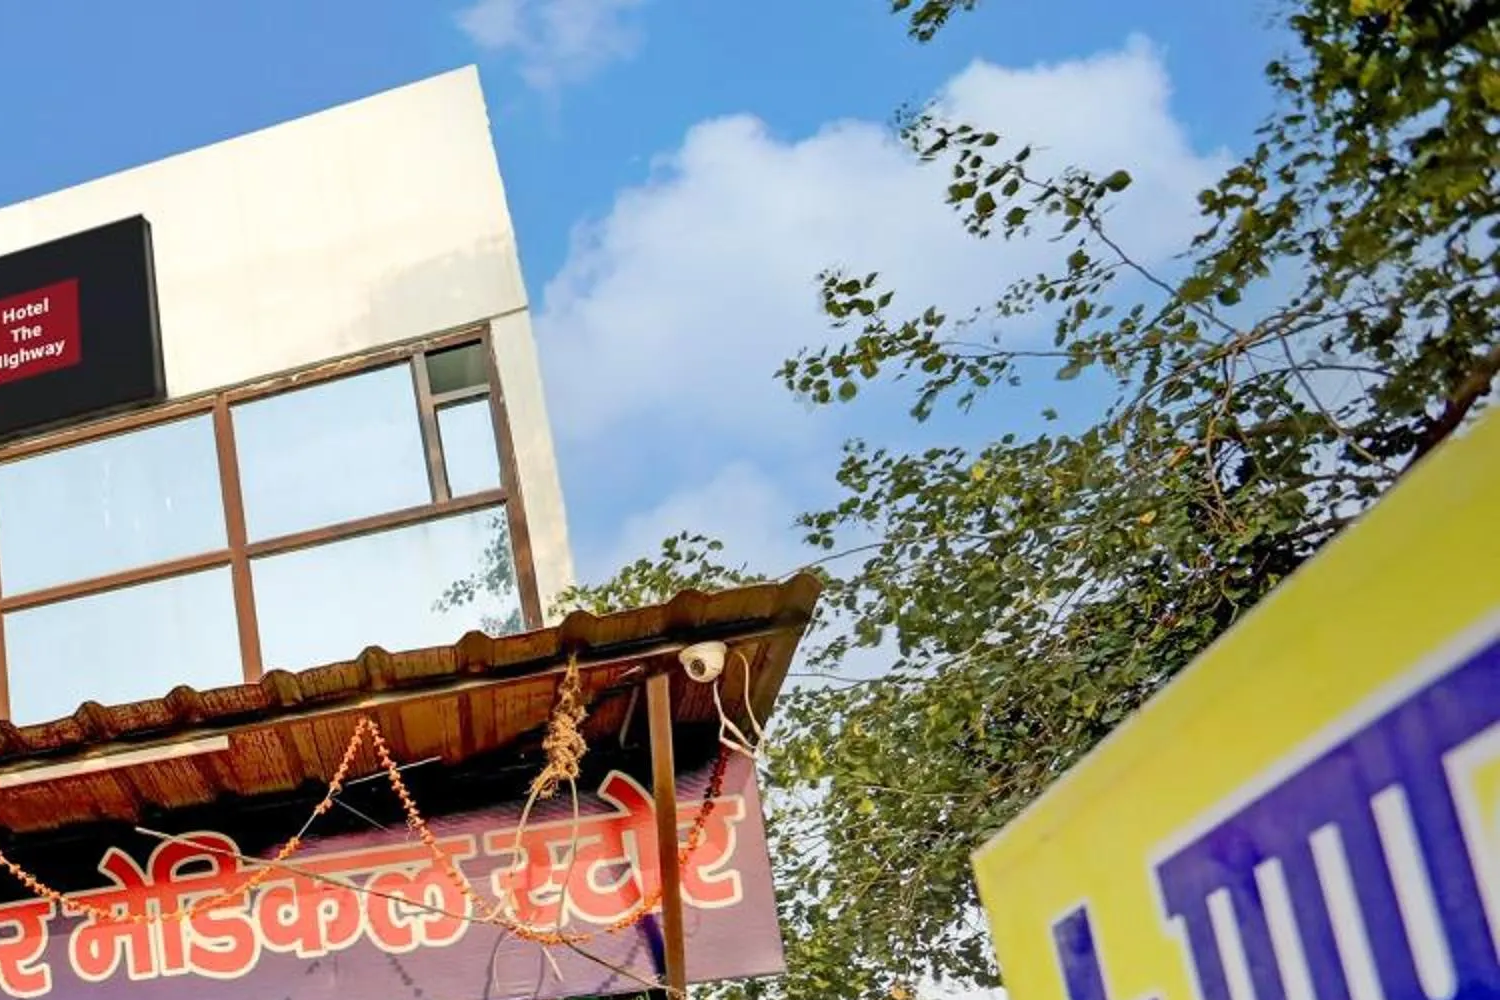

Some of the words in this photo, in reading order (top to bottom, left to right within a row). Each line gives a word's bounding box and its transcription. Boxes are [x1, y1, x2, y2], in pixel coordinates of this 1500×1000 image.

[2, 297, 49, 325] Hotel
[10, 325, 43, 343] The
[62, 830, 476, 981] मेडिकल
[483, 769, 746, 933] स्टोर
